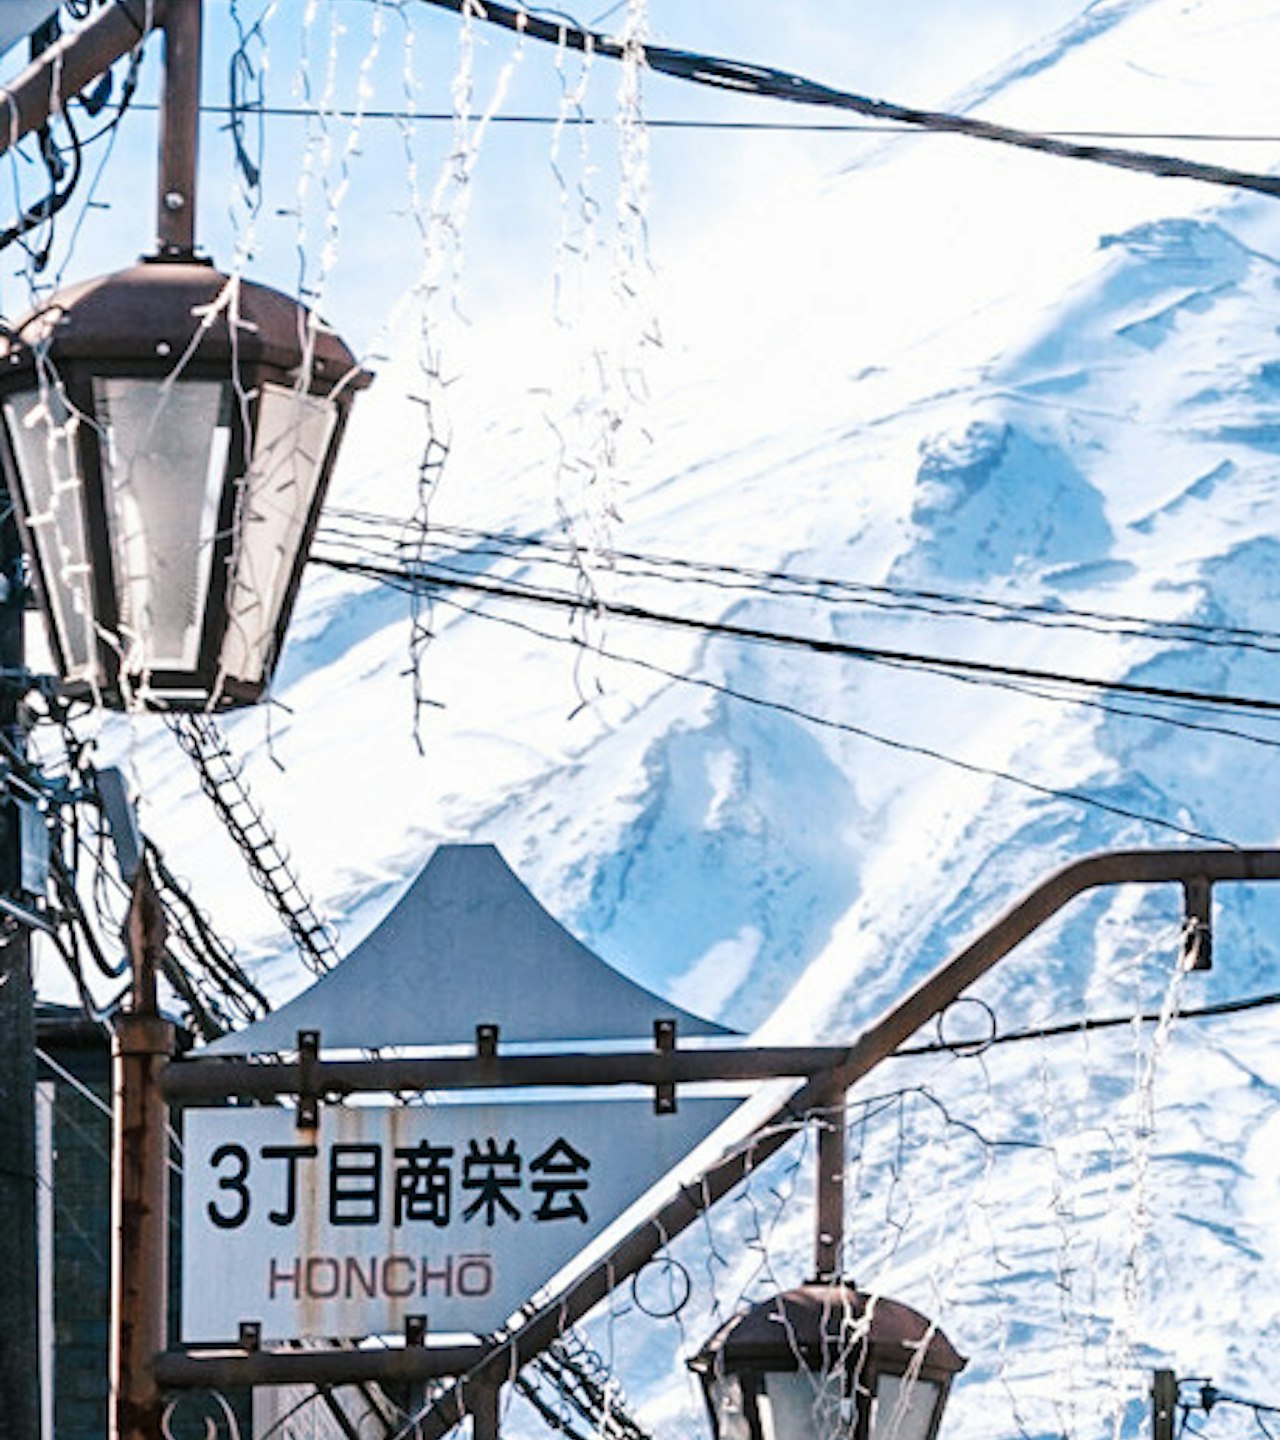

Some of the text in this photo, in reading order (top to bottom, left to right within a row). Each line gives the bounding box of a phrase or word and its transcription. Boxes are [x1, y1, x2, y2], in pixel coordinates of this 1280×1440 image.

[207, 1137, 591, 1231] 3丁目商栄会
